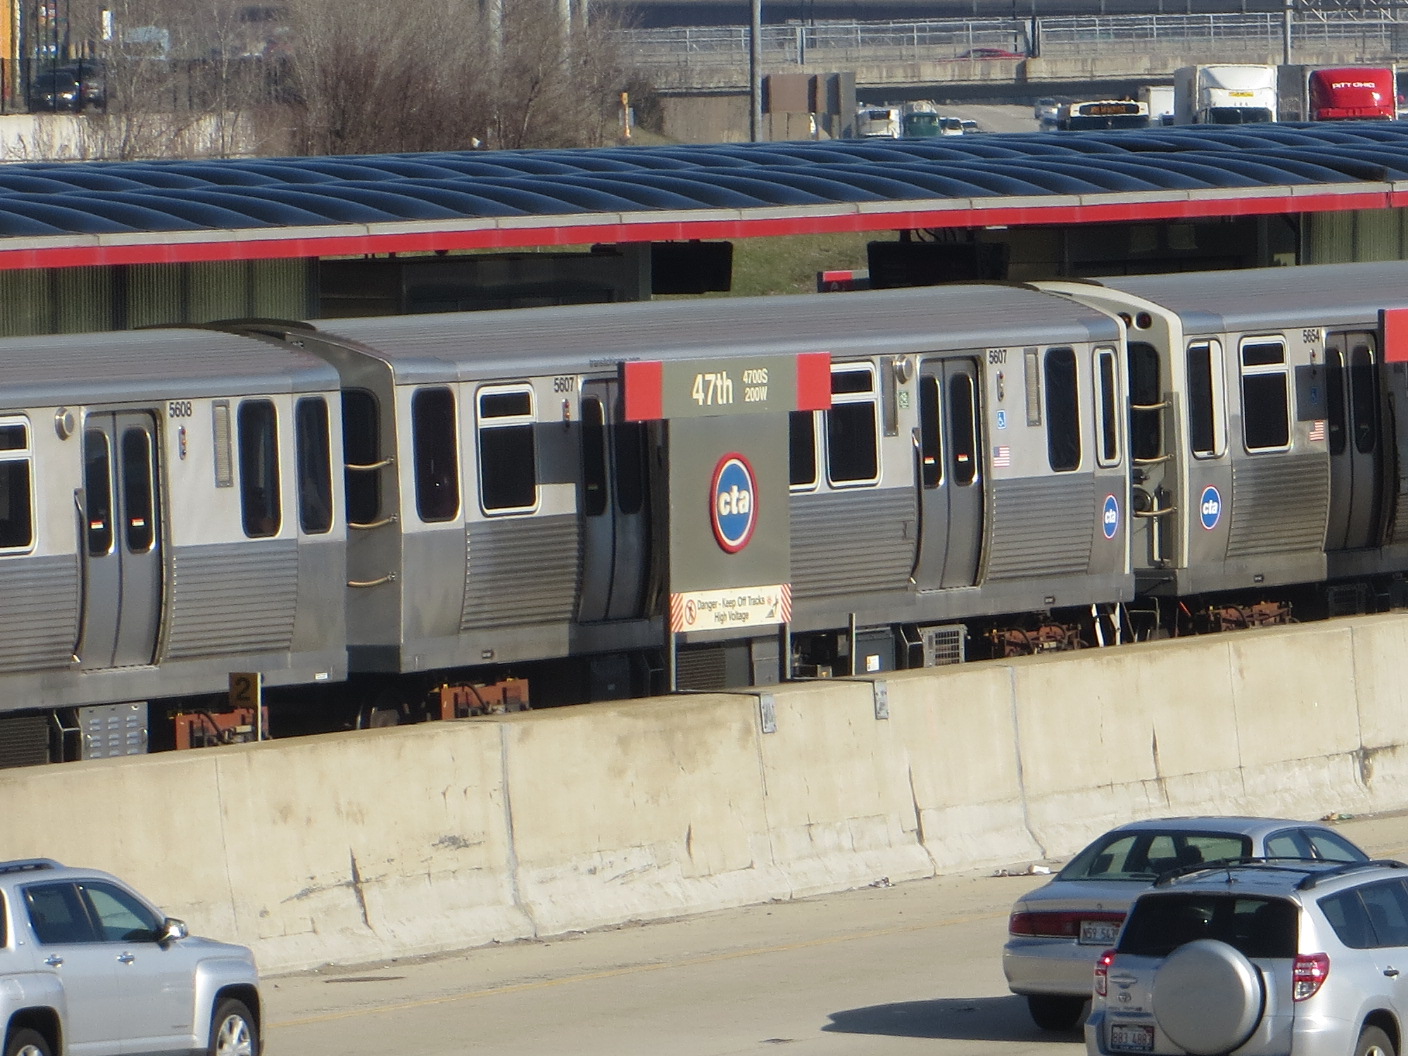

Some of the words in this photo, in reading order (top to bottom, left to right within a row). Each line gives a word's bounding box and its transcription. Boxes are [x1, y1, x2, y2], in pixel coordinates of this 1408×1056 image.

[989, 349, 1007, 364] 5607
[742, 368, 768, 384] 4700S
[554, 377, 574, 392] 5607
[692, 371, 733, 406] 47th
[744, 386, 768, 402] 200W
[169, 401, 192, 418] 5608
[718, 485, 750, 516] cta
[1203, 500, 1218, 514] cta
[1105, 509, 1116, 524] cta
[697, 599, 718, 611] Danger
[722, 597, 736, 609] Keep
[737, 596, 747, 606] Off
[748, 595, 765, 606] Tracks
[714, 612, 727, 624] High
[729, 610, 749, 622] Voltage
[236, 677, 251, 700] 2
